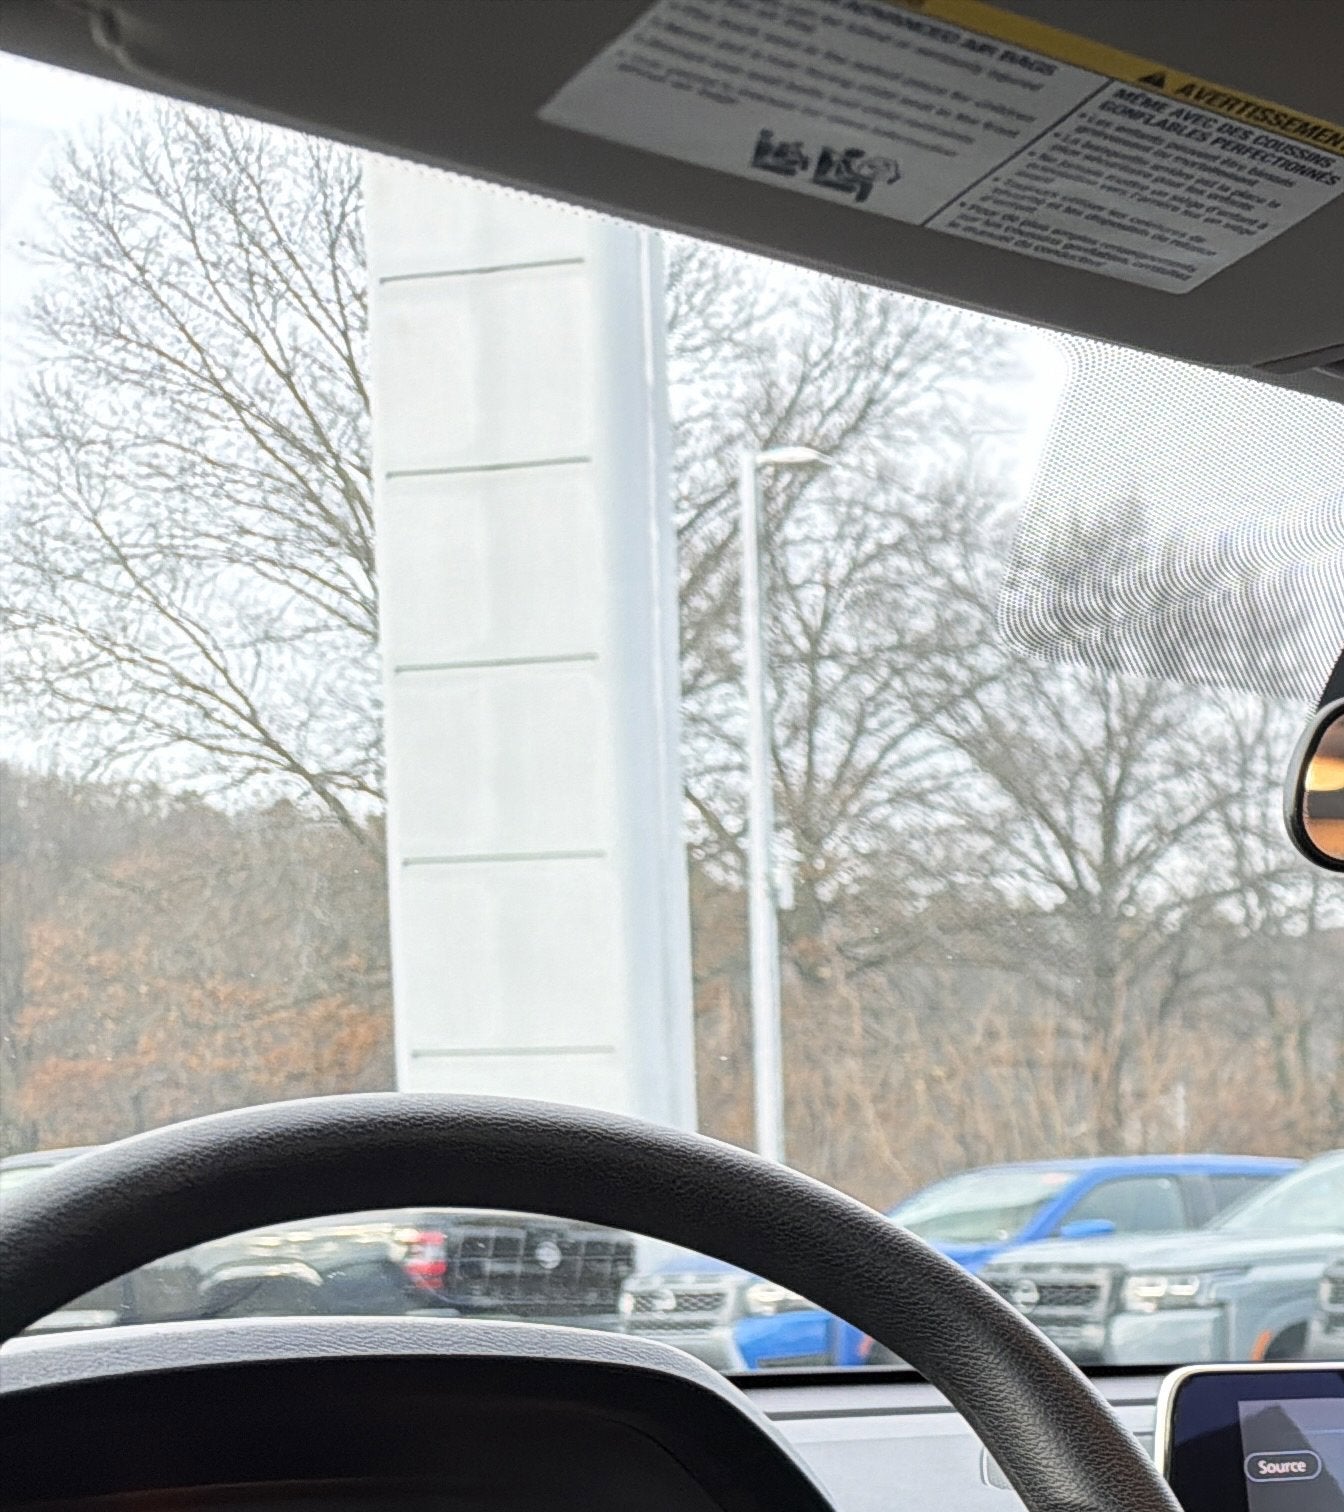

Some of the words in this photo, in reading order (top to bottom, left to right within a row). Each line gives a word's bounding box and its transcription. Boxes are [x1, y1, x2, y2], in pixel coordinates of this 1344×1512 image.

[1098, 100, 1210, 142] GONFLABLES
[1208, 136, 1342, 185] PERFECTIONNÉS
[1112, 87, 1169, 112] MÊME
[1167, 107, 1219, 129] AVEC
[1215, 123, 1254, 141] DES
[1251, 134, 1336, 168] COUSSINS
[1257, 1457, 1307, 1475] Source
